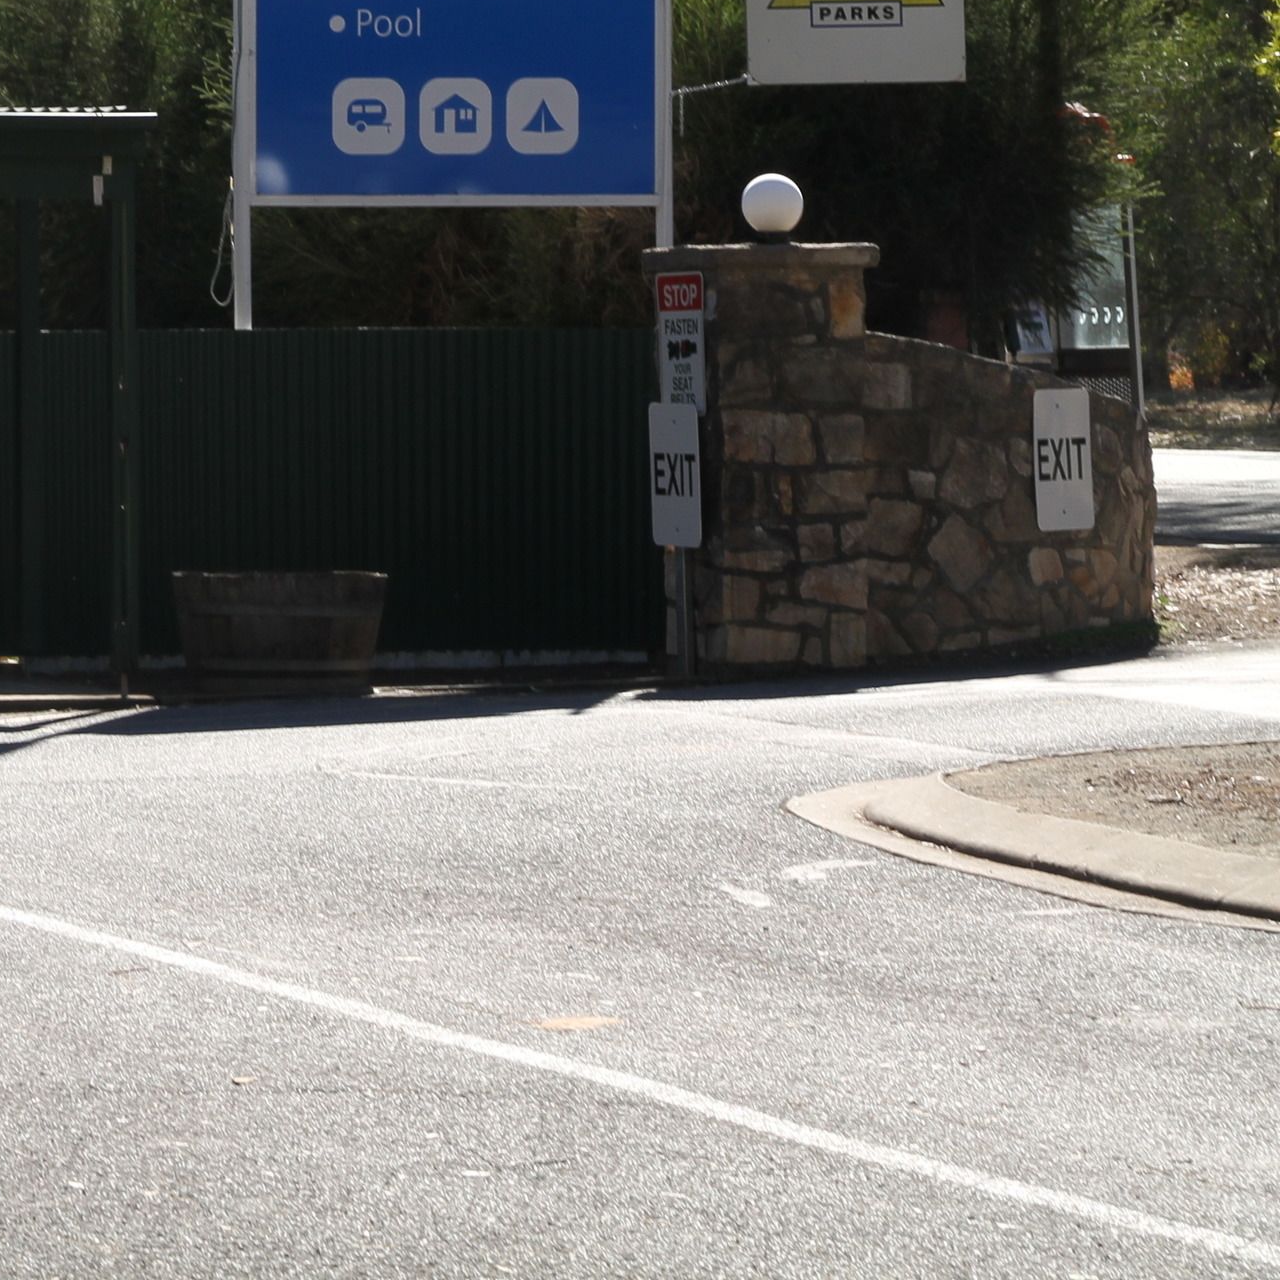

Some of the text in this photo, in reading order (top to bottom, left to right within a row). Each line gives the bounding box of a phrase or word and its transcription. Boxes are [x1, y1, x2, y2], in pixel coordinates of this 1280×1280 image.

[356, 7, 421, 38] Pool
[819, 5, 895, 21] PARKS
[663, 284, 698, 307] STOP
[664, 318, 699, 335] FASTEN
[673, 362, 692, 375] YOUR
[672, 376, 694, 392] SEAT
[1037, 437, 1087, 481] EXIT
[653, 452, 696, 497] EXIT
